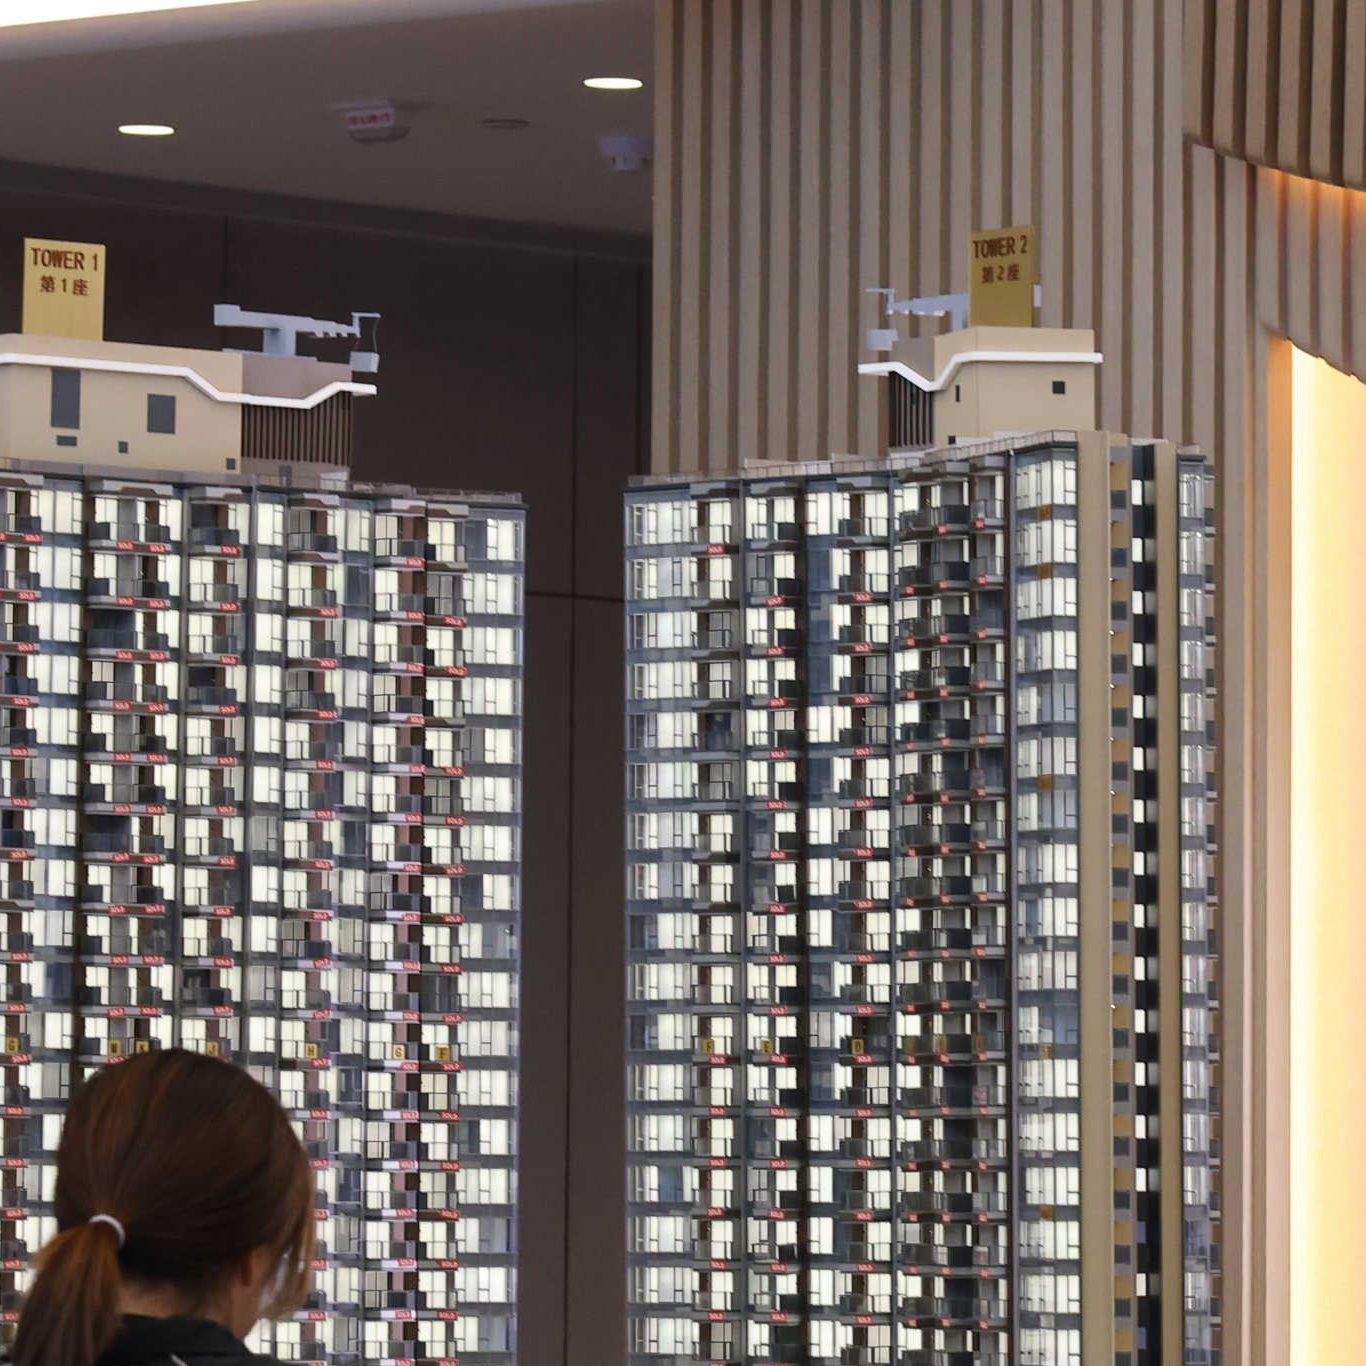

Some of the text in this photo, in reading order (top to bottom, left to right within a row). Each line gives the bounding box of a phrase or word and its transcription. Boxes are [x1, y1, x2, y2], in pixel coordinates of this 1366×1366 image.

[973, 235, 1028, 259] TOWER 2
[31, 247, 98, 272] TOWER 1
